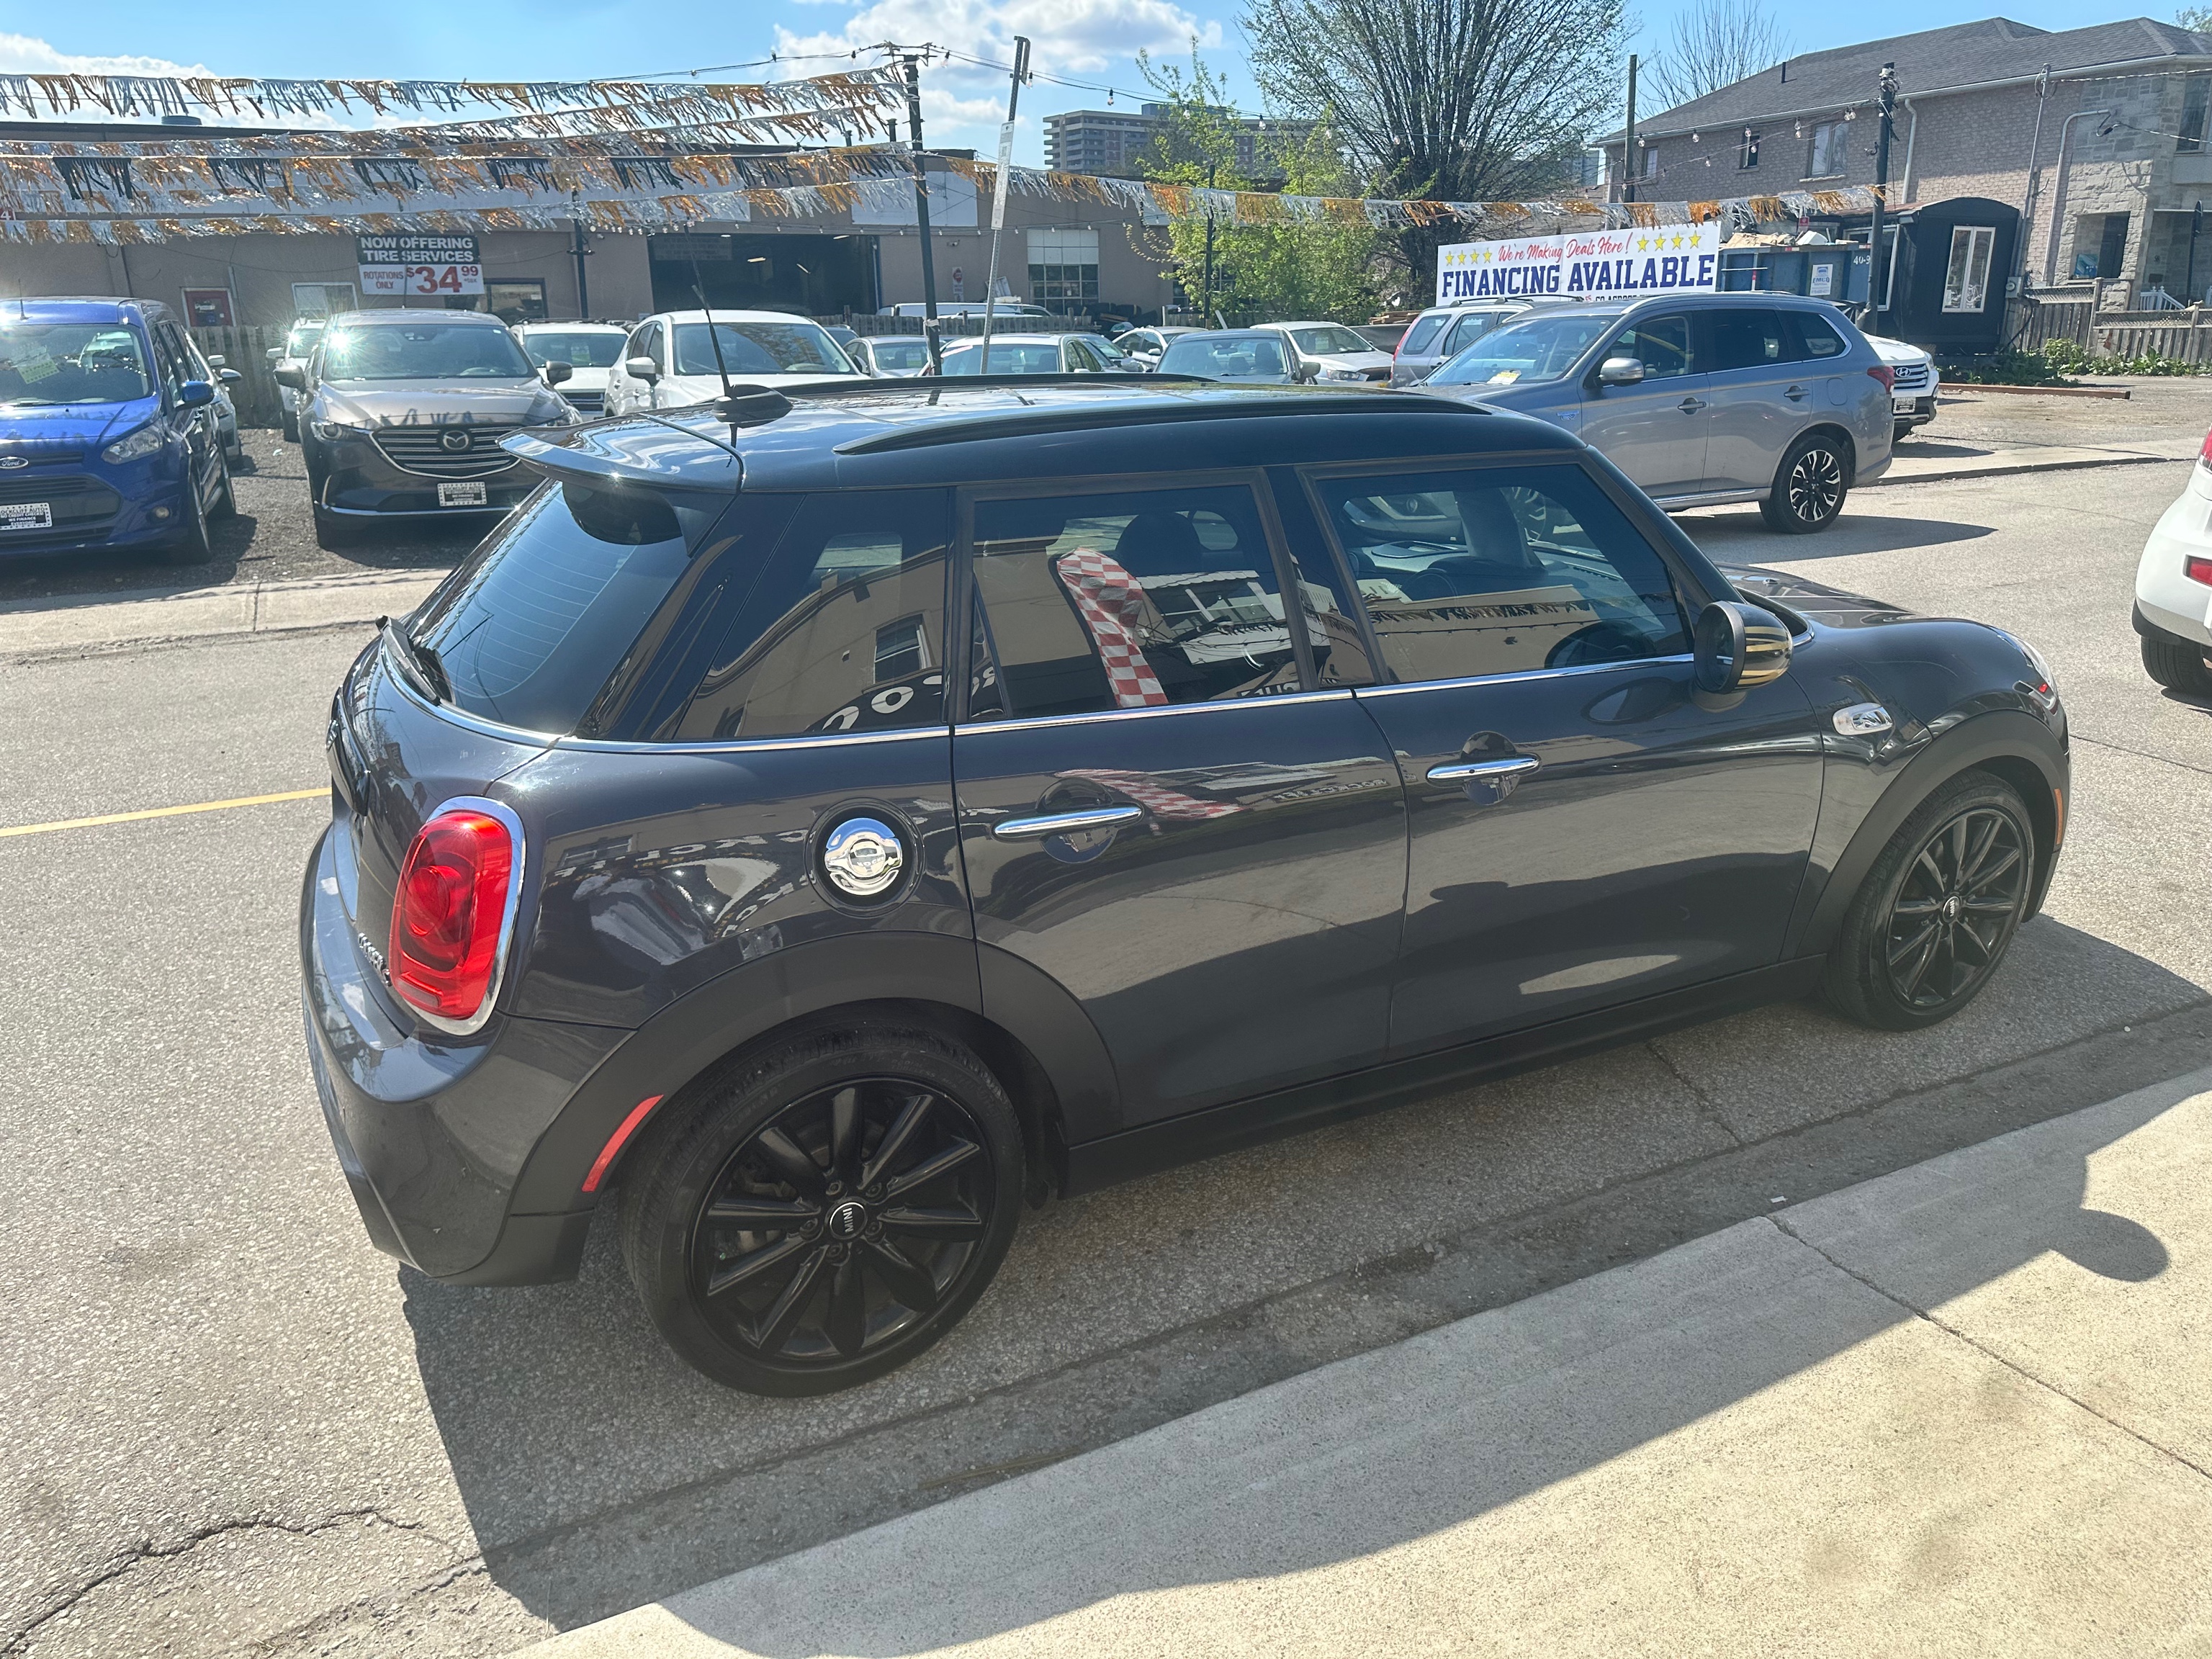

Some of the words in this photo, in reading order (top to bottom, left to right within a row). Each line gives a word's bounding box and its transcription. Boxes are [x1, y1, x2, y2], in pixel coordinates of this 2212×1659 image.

[361, 237, 396, 248] NOW
[400, 237, 473, 248] OFFERING
[1498, 243, 1524, 261] We're
[1527, 243, 1563, 263] Making
[1566, 238, 1594, 258] Deals
[363, 251, 399, 261] TIRE
[402, 251, 474, 261] SERVICES
[364, 271, 404, 280] ROTATIONS
[1442, 264, 1561, 297] FINANCING
[1568, 254, 1716, 292] AVAILABLE
[842, 1208, 854, 1233] MINI
